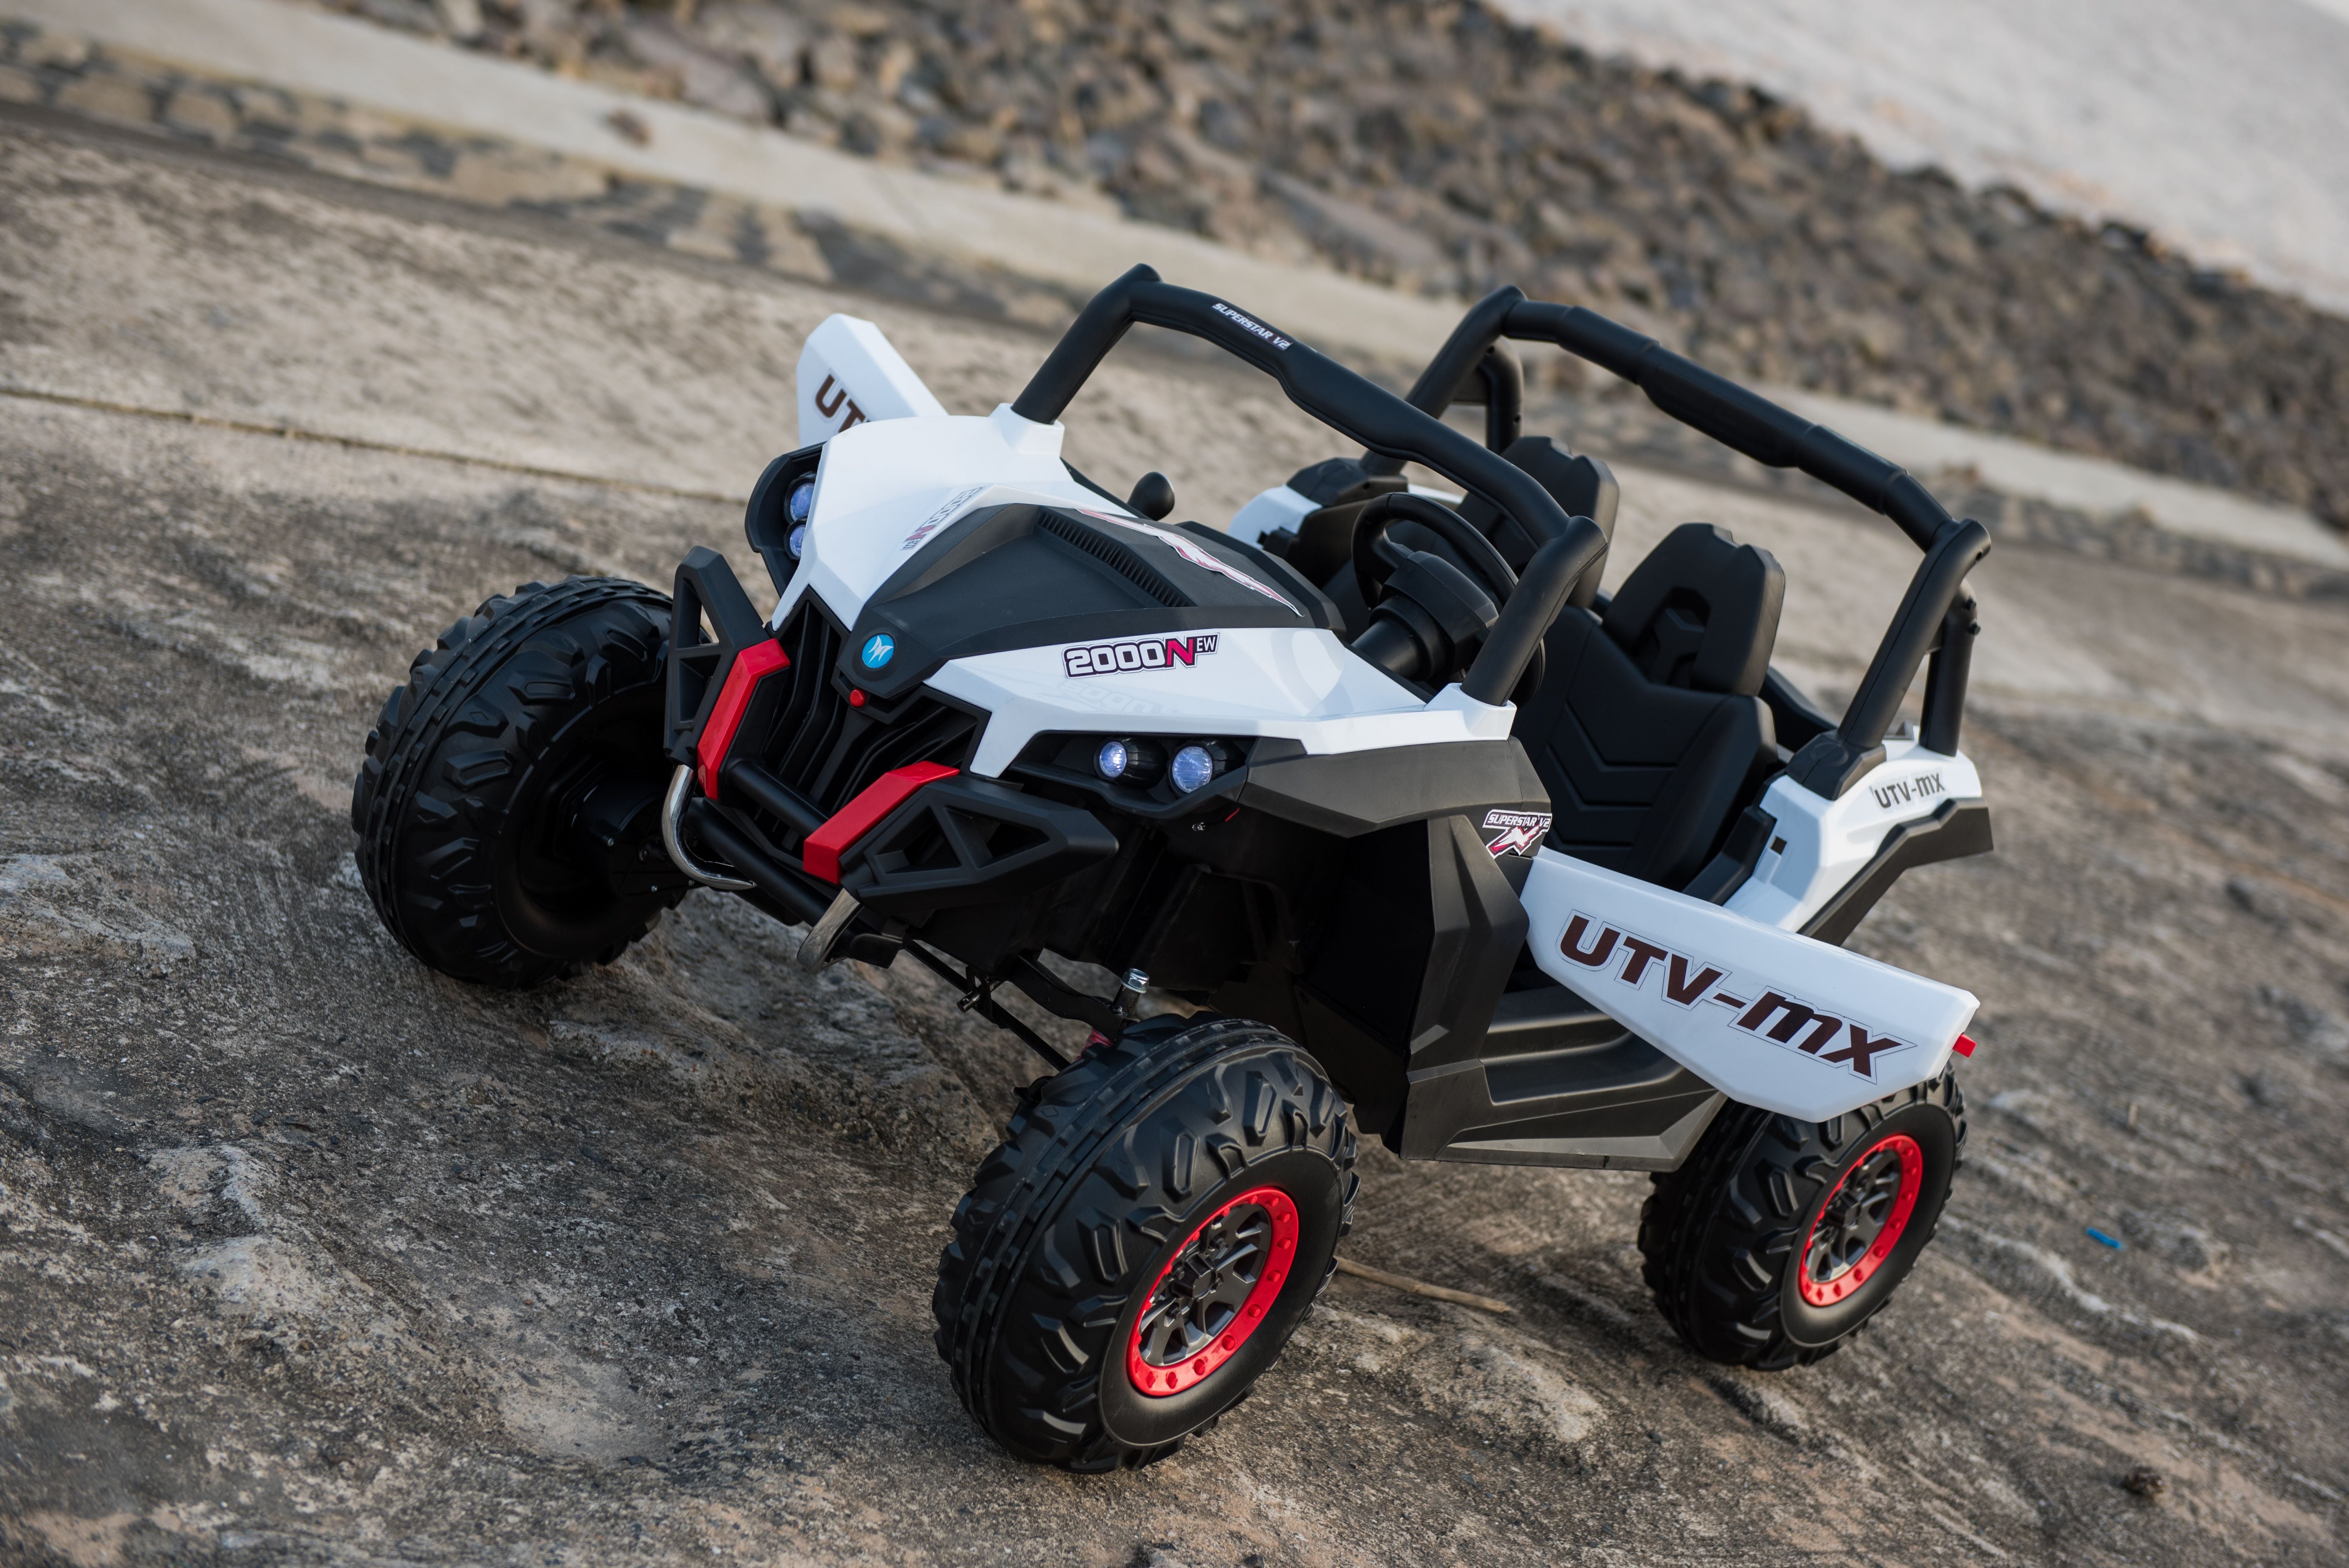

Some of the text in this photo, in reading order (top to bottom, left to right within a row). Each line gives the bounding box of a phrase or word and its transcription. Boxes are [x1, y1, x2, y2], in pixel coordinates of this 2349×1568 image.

[1213, 303, 1291, 349] SUPERSTAR V2
[1487, 813, 1551, 827] SUPERSTAR V2
